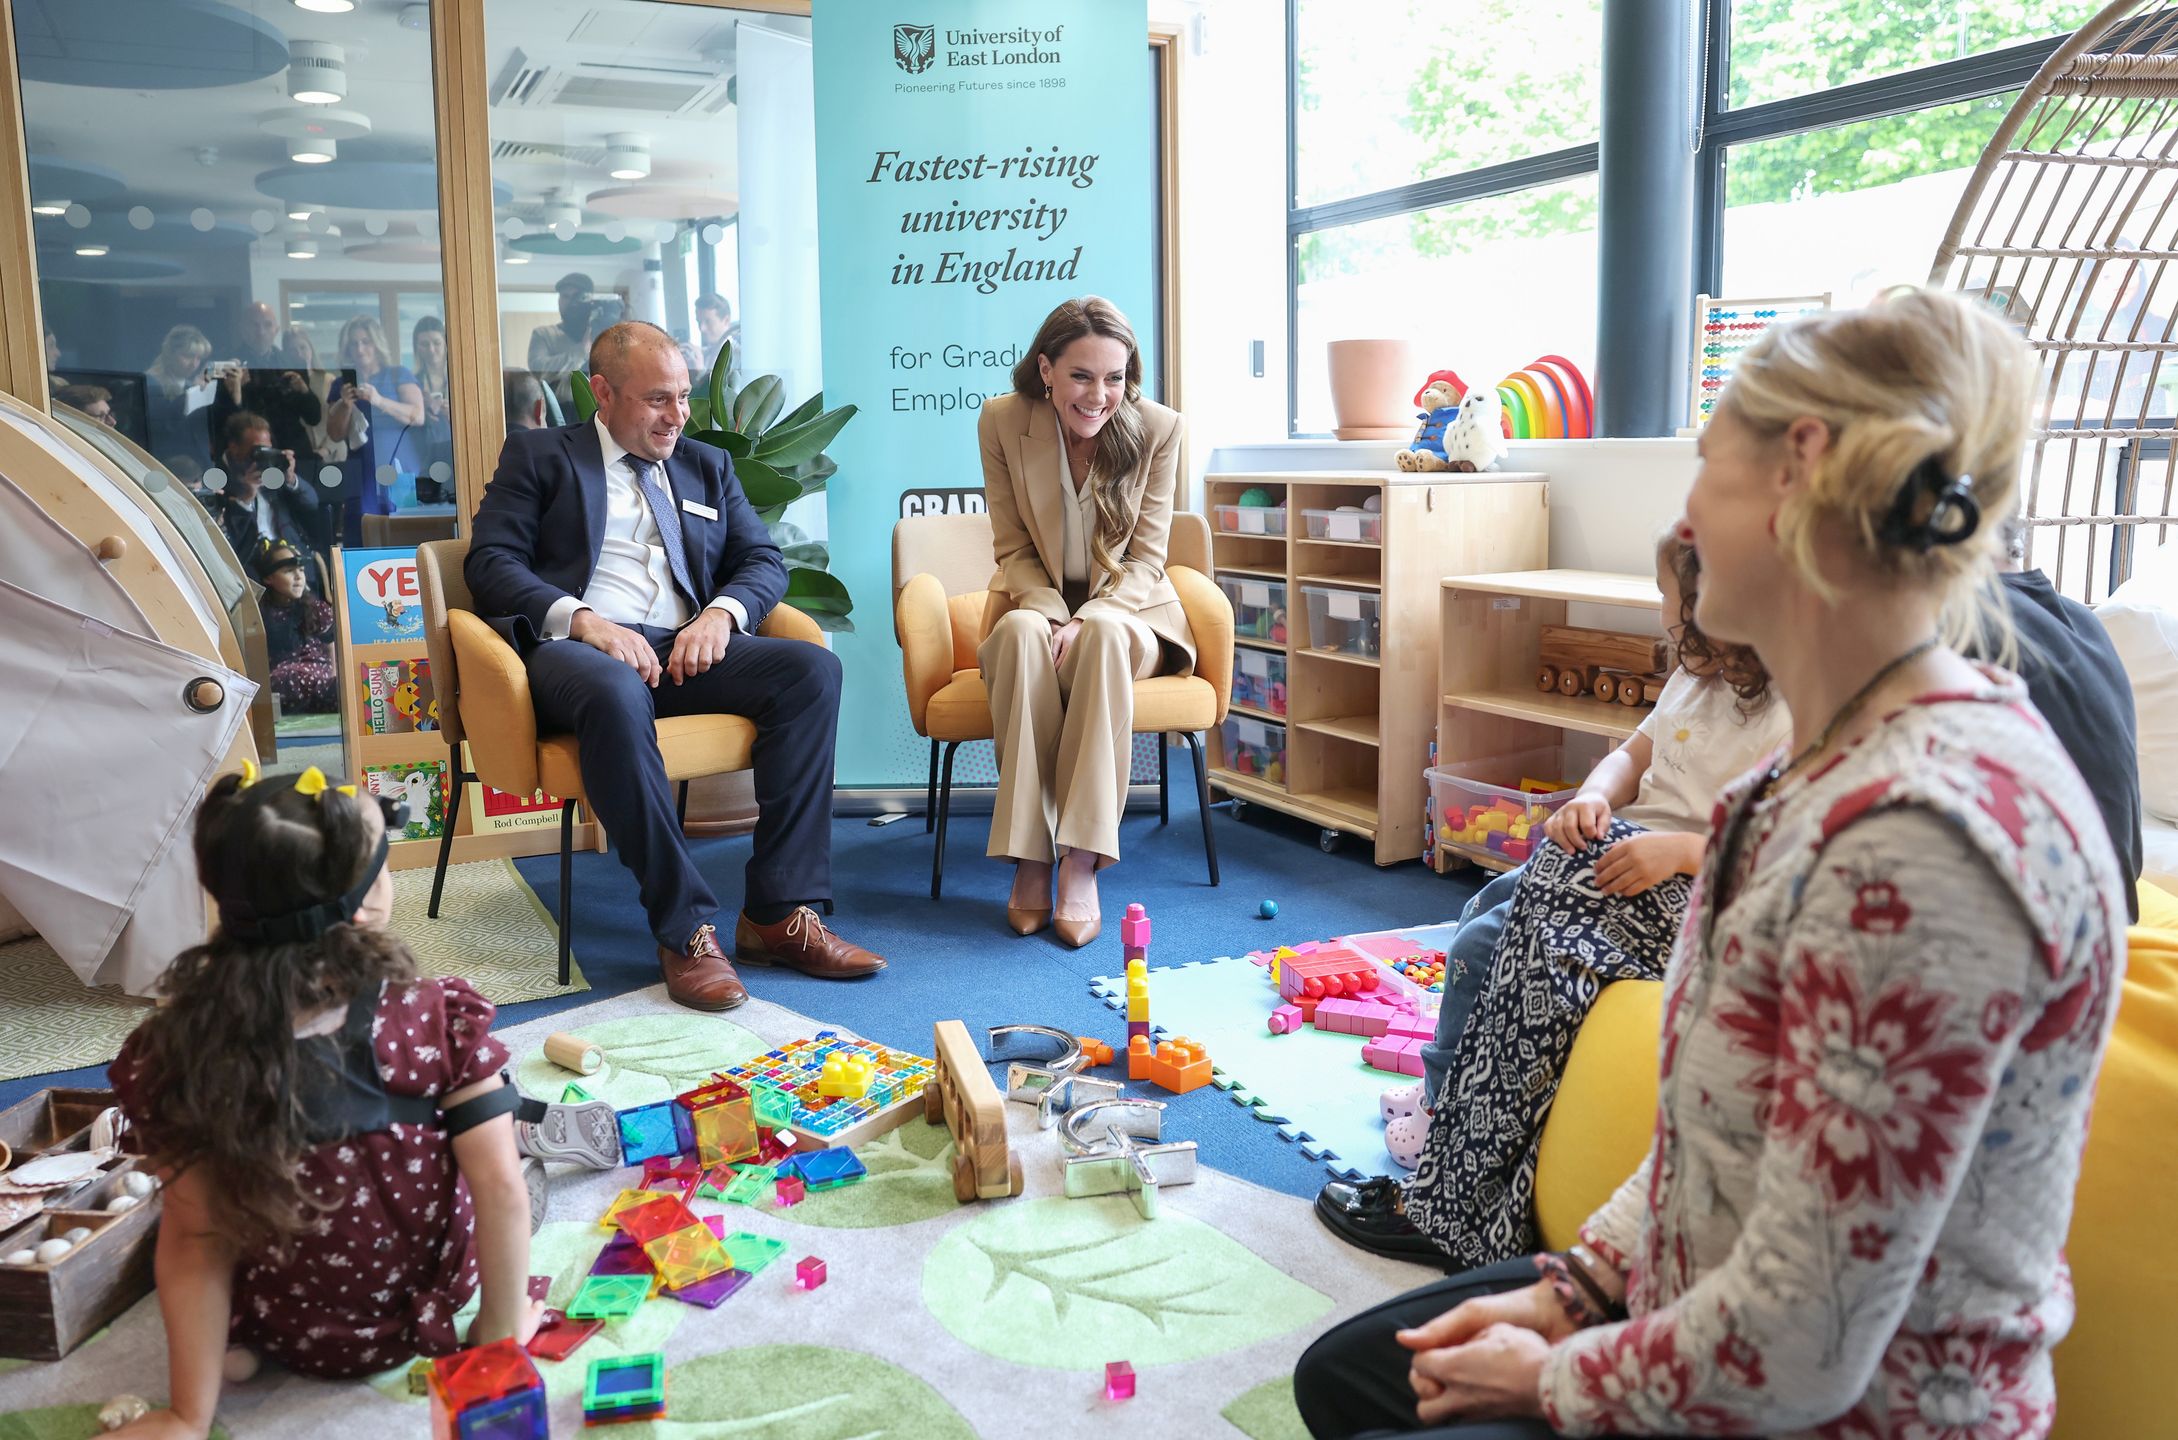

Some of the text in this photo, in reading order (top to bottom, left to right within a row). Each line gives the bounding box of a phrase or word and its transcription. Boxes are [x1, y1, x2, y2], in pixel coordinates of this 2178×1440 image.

[945, 25, 1064, 47] University of
[946, 48, 1061, 67] East London
[894, 77, 1066, 94] Pioneering Futures since 1898
[866, 146, 1100, 189] Fastest-rising
[900, 198, 1068, 242] university
[890, 245, 1084, 294] in England
[889, 346, 932, 370] for
[892, 386, 1010, 416] Emplo
[902, 493, 989, 519] GRAD
[367, 566, 420, 598] YE
[372, 698, 386, 735] HELLO
[493, 813, 559, 829] Rod Campbell
